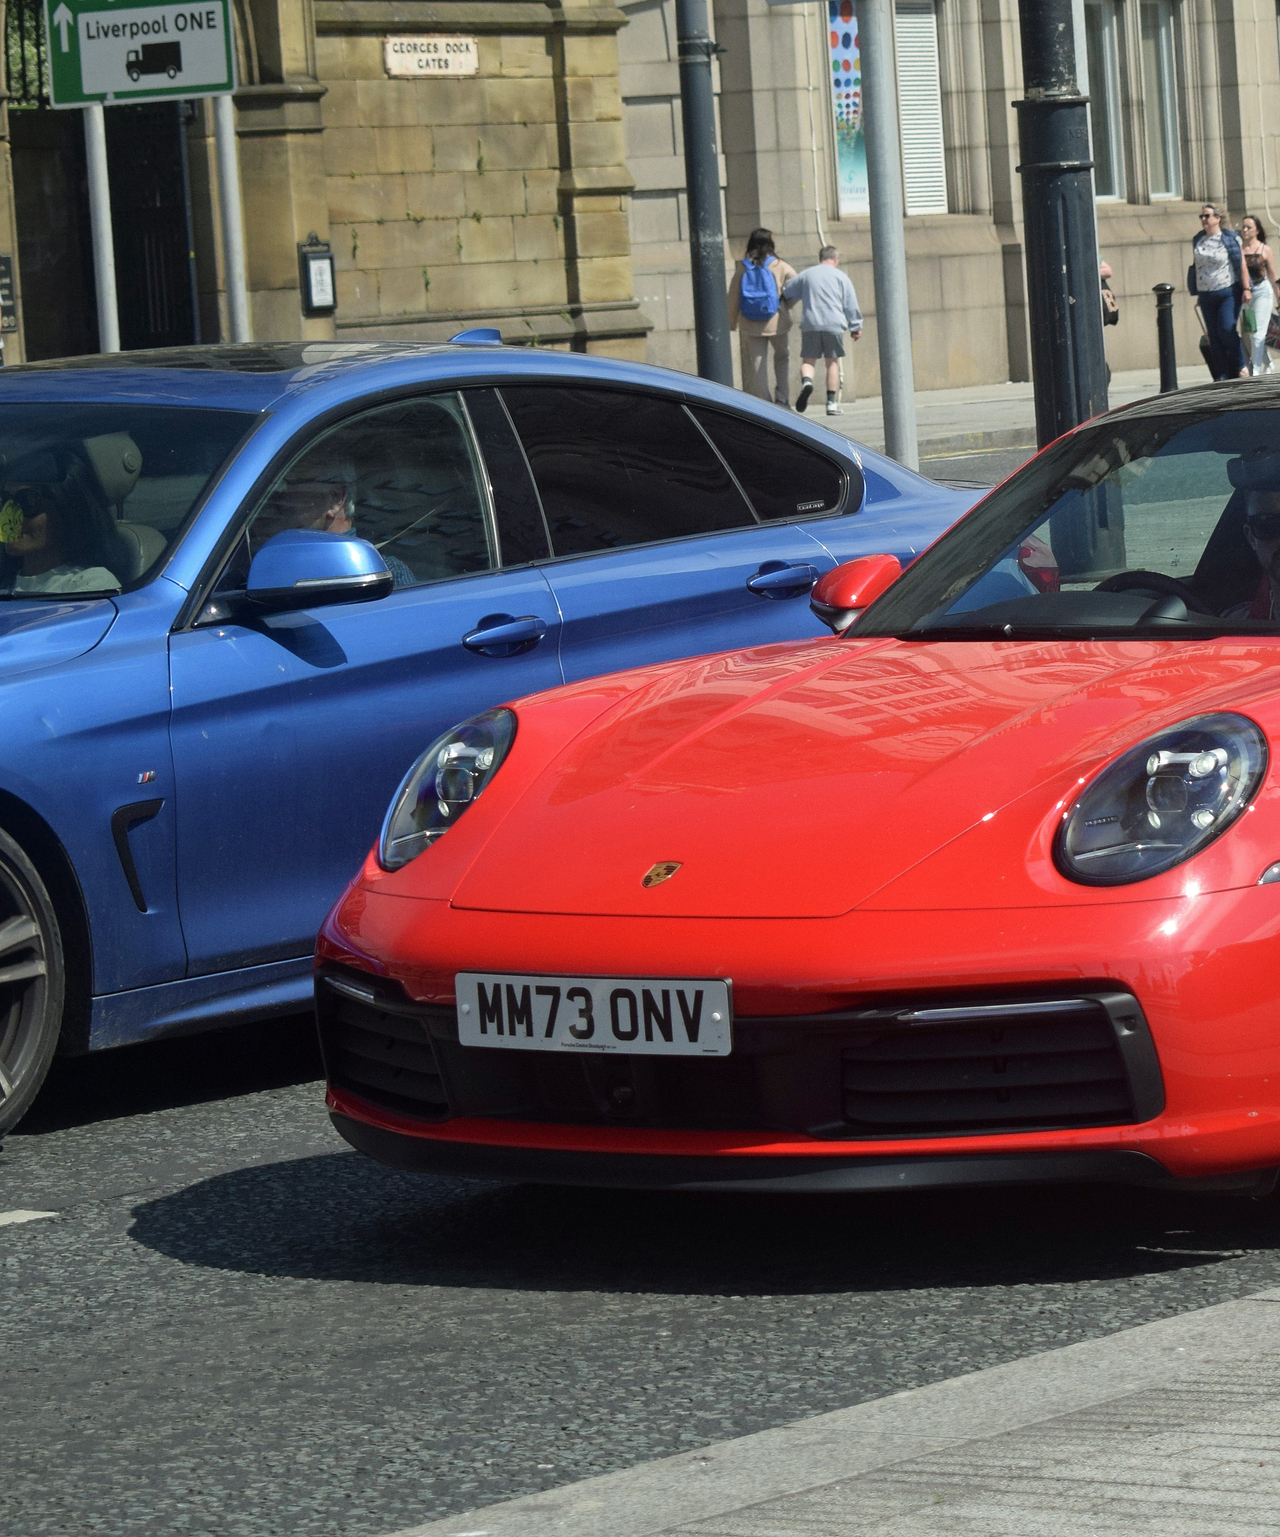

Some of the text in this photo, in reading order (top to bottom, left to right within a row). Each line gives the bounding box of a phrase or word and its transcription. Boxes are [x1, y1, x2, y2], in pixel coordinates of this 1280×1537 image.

[86, 11, 217, 40] Liverpool ONE
[445, 43, 471, 53] DOCK
[477, 982, 704, 1042] MM73 ONV
